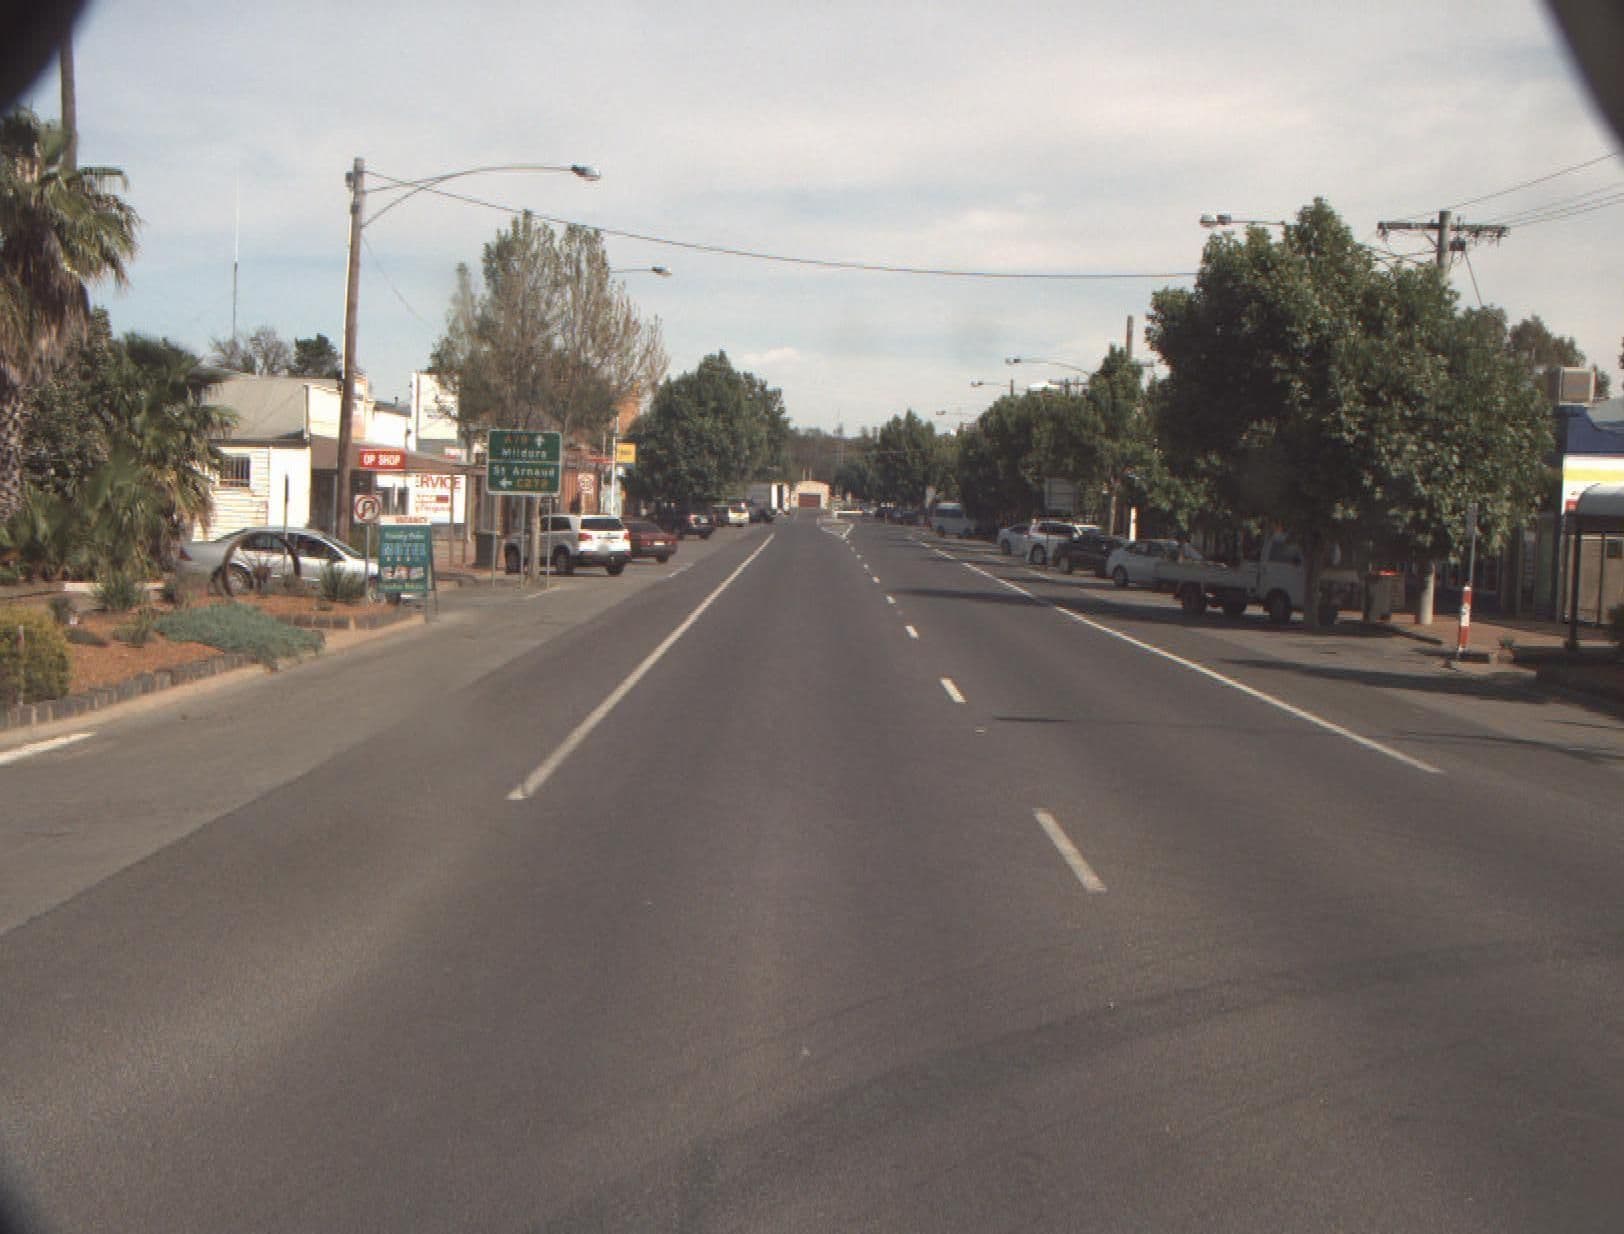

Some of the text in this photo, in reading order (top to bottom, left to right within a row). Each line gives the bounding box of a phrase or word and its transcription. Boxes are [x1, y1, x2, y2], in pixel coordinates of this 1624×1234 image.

[502, 447, 547, 459] Mildura
[363, 454, 401, 466] OP SHOP
[493, 464, 555, 478] St Arnaud
